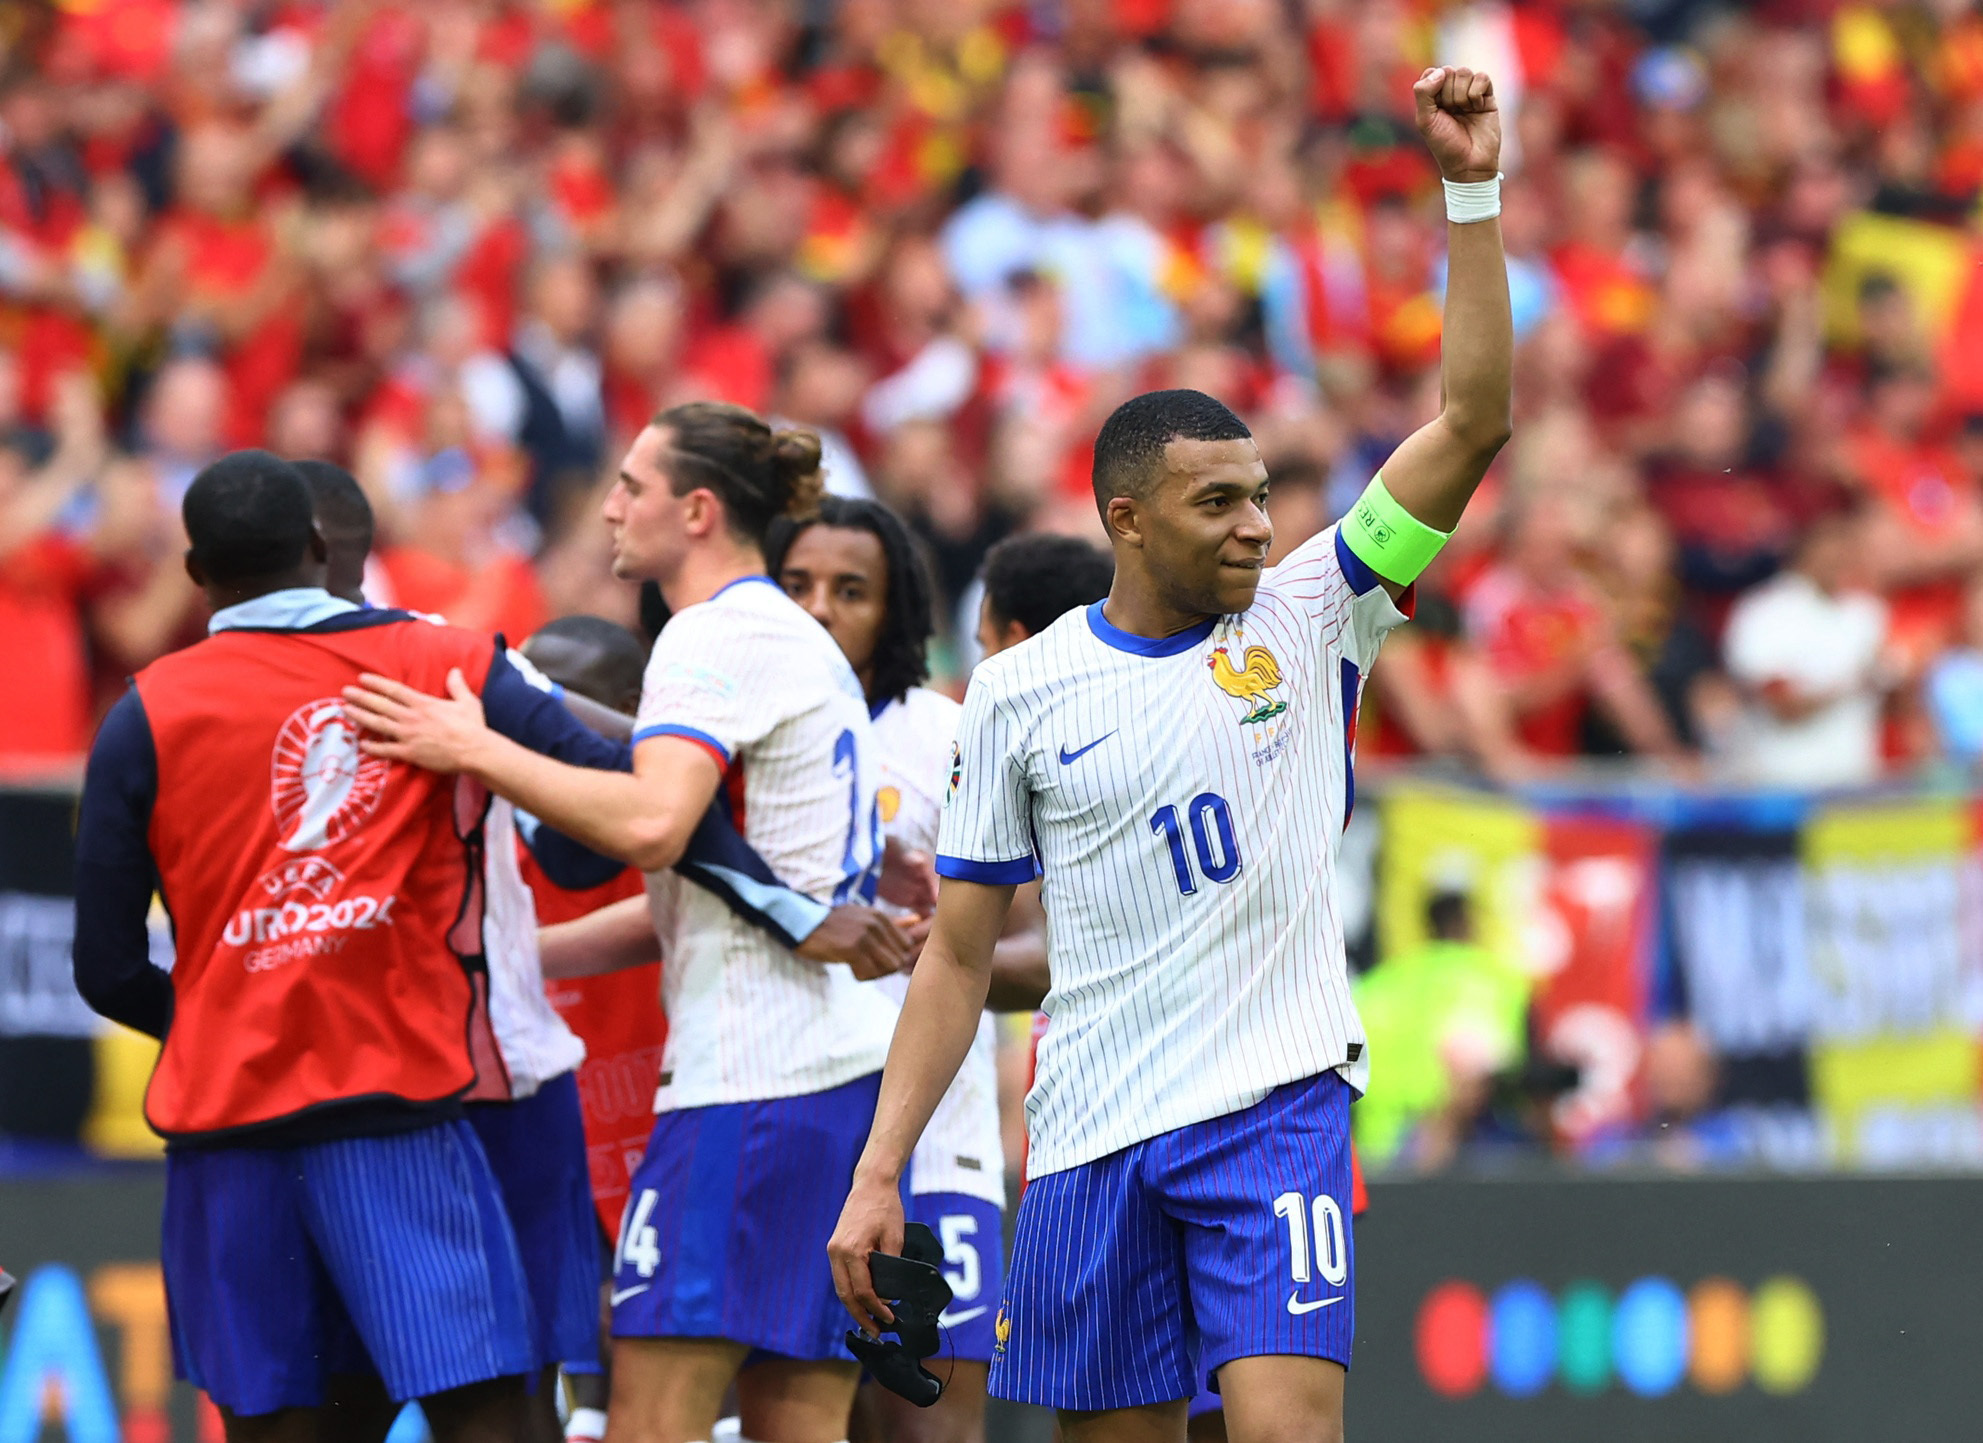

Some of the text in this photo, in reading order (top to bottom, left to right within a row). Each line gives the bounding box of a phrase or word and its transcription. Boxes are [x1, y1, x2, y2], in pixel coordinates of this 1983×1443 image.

[262, 862, 336, 895] UEFA
[1150, 792, 1243, 896] 10
[221, 896, 396, 946] URO2024
[244, 935, 348, 973] GERMANY
[613, 1188, 661, 1278] 14
[939, 1214, 982, 1302] 5
[1273, 1191, 1347, 1287] 10
